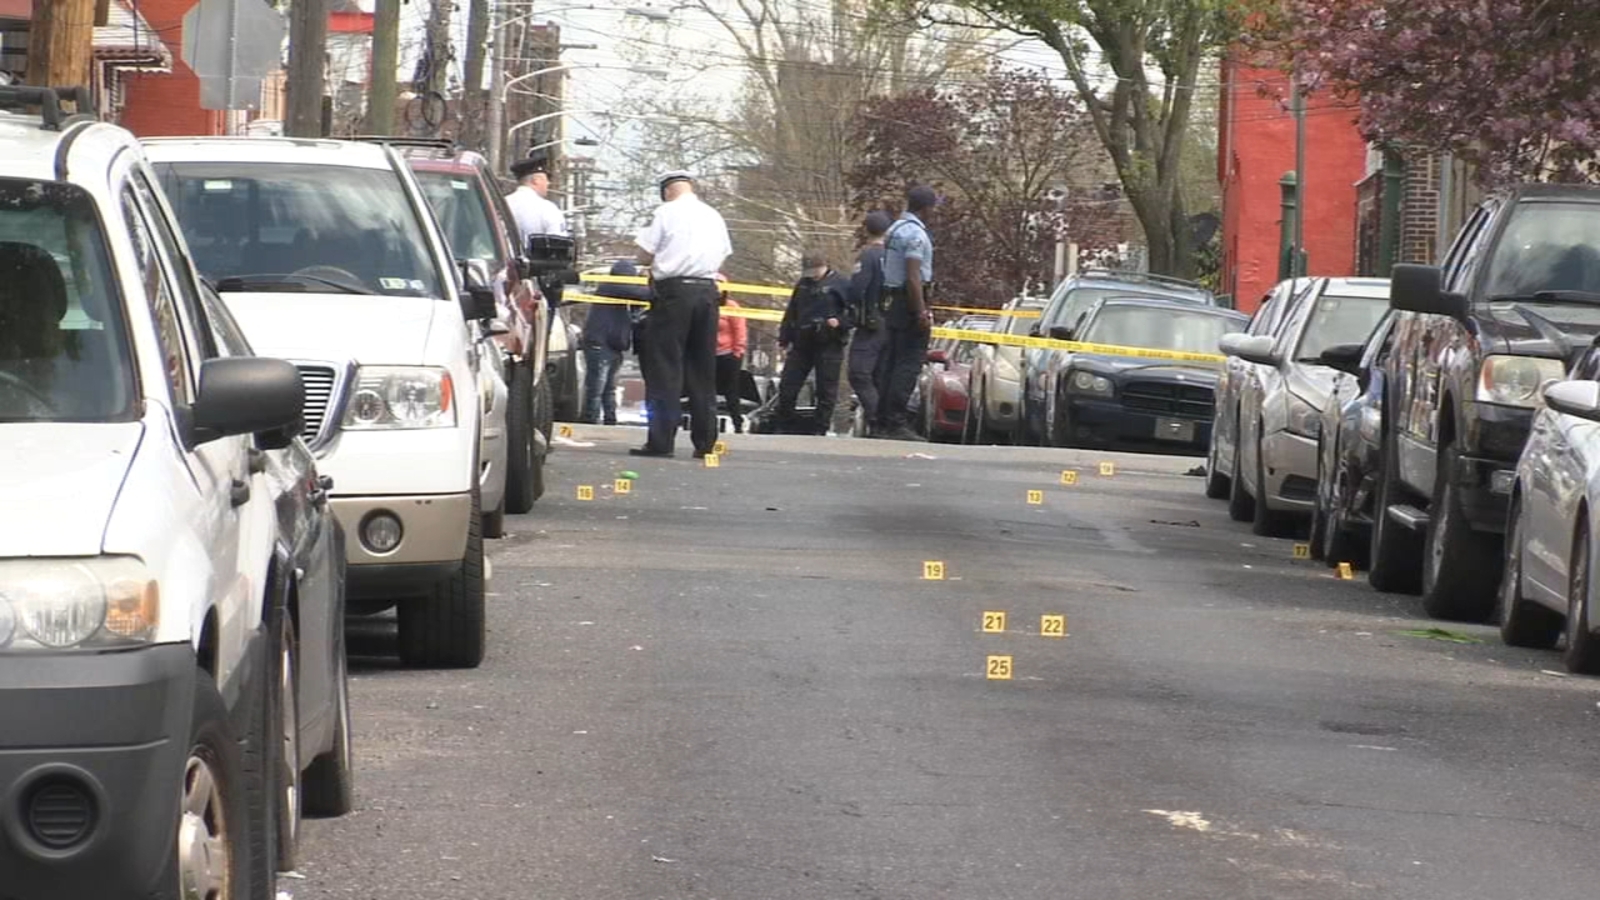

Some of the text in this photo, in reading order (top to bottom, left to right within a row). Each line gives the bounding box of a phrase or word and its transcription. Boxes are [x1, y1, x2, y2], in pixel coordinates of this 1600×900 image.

[1296, 546, 1307, 556] 17
[927, 565, 941, 577] 19
[985, 616, 1002, 629] 21
[1044, 620, 1061, 632] 22
[990, 660, 1008, 675] 25
